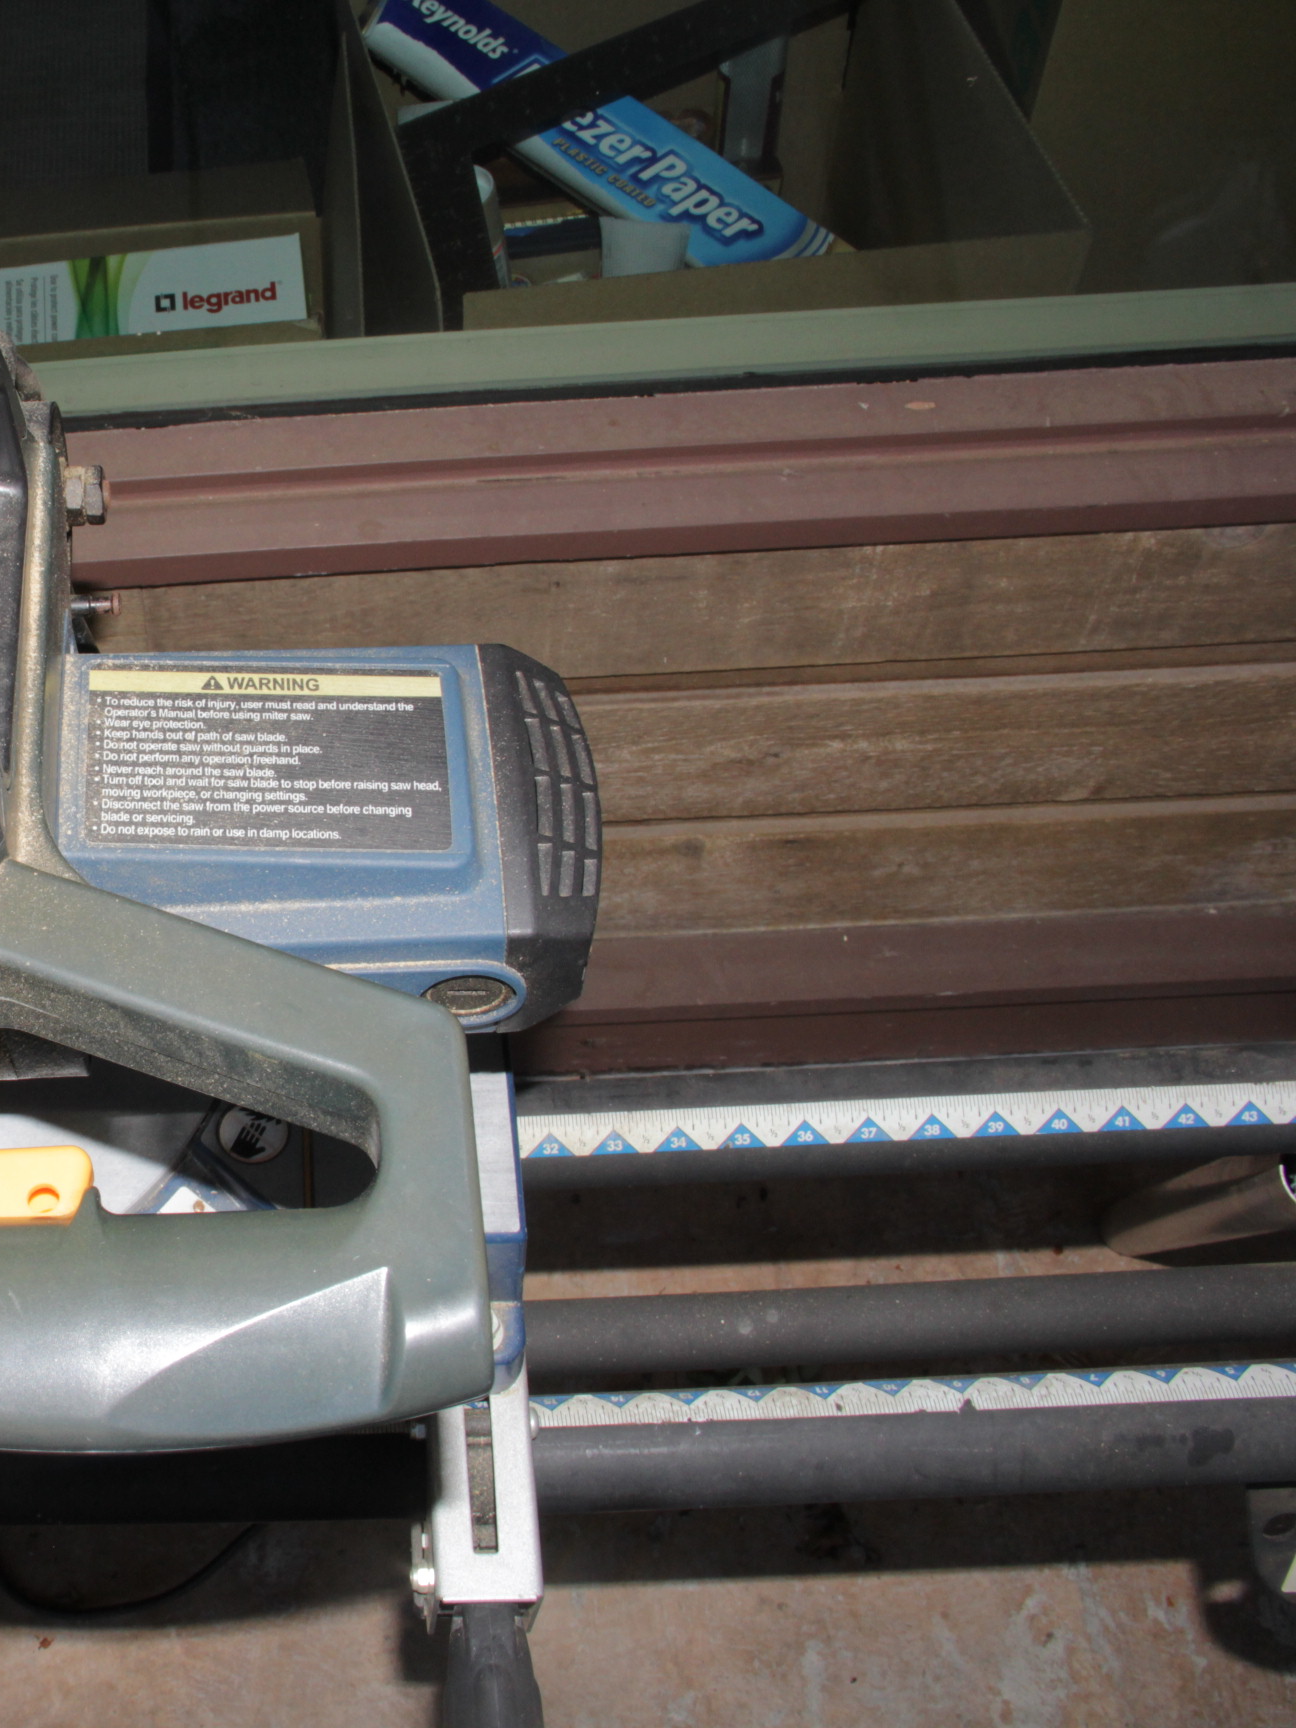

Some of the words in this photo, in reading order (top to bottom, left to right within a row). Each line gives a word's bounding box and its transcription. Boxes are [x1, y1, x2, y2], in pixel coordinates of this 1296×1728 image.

[411, 0, 508, 59] eynolds
[553, 137, 606, 175] PLASTIC
[607, 172, 656, 208] COATED
[638, 154, 759, 237] Paper
[182, 281, 277, 314] legrand
[227, 677, 320, 691] WARNING
[105, 696, 118, 706] To
[120, 696, 154, 707] reduce
[156, 697, 172, 707] the
[174, 697, 193, 707] risk
[195, 698, 206, 708] of
[208, 698, 238, 710] injury,
[240, 700, 262, 709] user
[265, 699, 291, 709] must
[293, 699, 315, 710] read
[318, 700, 336, 710] and
[338, 700, 396, 711] understand
[398, 701, 414, 711] the
[104, 707, 156, 719] Operator's
[158, 708, 195, 718] Manual
[197, 708, 230, 719] before
[232, 709, 260, 722] using
[262, 710, 288, 720] miter
[290, 712, 314, 721] saw.
[104, 717, 130, 728] Wear
[132, 720, 150, 730] eye
[153, 718, 206, 732] protection.
[104, 728, 130, 741] Keep
[132, 729, 164, 739] hands
[166, 730, 183, 740] out
[185, 730, 195, 740] of
[197, 730, 220, 743] path
[222, 731, 233, 741] of
[234, 733, 254, 741] saw
[257, 732, 288, 742] blade.
[104, 739, 118, 749] Do
[120, 739, 137, 750] not
[139, 740, 178, 753] operate
[179, 743, 201, 751] saw
[203, 741, 240, 752] without
[242, 742, 279, 755] guards
[280, 743, 290, 753] in
[292, 744, 323, 756] place.
[103, 751, 118, 761] Do
[120, 751, 137, 761] not
[139, 752, 180, 764] perform
[181, 755, 200, 765] any
[202, 753, 252, 766] operation
[253, 754, 301, 765] freehand.
[102, 764, 132, 774] Never
[134, 764, 164, 775] reach
[166, 765, 202, 776] around
[204, 766, 221, 777] the
[222, 769, 244, 777] saw
[246, 768, 277, 778] blade.
[102, 775, 126, 785] Turn
[129, 775, 142, 785] off
[144, 776, 164, 786] tool
[166, 776, 186, 786] and
[188, 776, 209, 787] wait
[210, 777, 225, 787] for
[227, 779, 248, 787] saw
[250, 778, 279, 788] blade
[280, 778, 292, 788] to
[293, 778, 316, 791] stop
[318, 779, 351, 789] before
[353, 780, 388, 792] raising
[390, 782, 412, 791] saw
[413, 781, 442, 793] head,
[102, 788, 140, 800] moving
[142, 788, 198, 801] workpiece,
[200, 791, 212, 799] or
[214, 790, 262, 802] changing
[264, 791, 308, 803] settings.
[101, 799, 161, 810] Disconnect
[163, 800, 180, 811] the
[182, 803, 204, 811] saw
[206, 801, 231, 812] from
[233, 802, 250, 812] the
[252, 804, 286, 815] power
[288, 805, 324, 814] source
[326, 804, 360, 814] before
[362, 805, 412, 817] changing
[100, 811, 130, 822] blade
[132, 814, 144, 822] or
[146, 812, 196, 826] servicing.
[100, 824, 116, 834] Do
[118, 824, 135, 835] not
[137, 827, 176, 838] expose
[177, 826, 188, 836] to
[190, 826, 210, 836] rain
[212, 829, 224, 837] or
[226, 829, 246, 837] use
[247, 828, 258, 838] in
[259, 828, 290, 841] damp
[291, 829, 342, 840] locations.
[543, 1143, 559, 1155] 32
[606, 1140, 623, 1151] 33
[670, 1136, 687, 1148] 34
[734, 1133, 751, 1145] 35
[797, 1130, 814, 1142] 36
[860, 1127, 877, 1139] 37
[924, 1124, 941, 1136] 38
[987, 1121, 1004, 1133] 39
[1051, 1118, 1068, 1130] 40
[1114, 1116, 1130, 1127] 41
[1178, 1113, 1195, 1124] 42
[1241, 1111, 1258, 1121] 43
